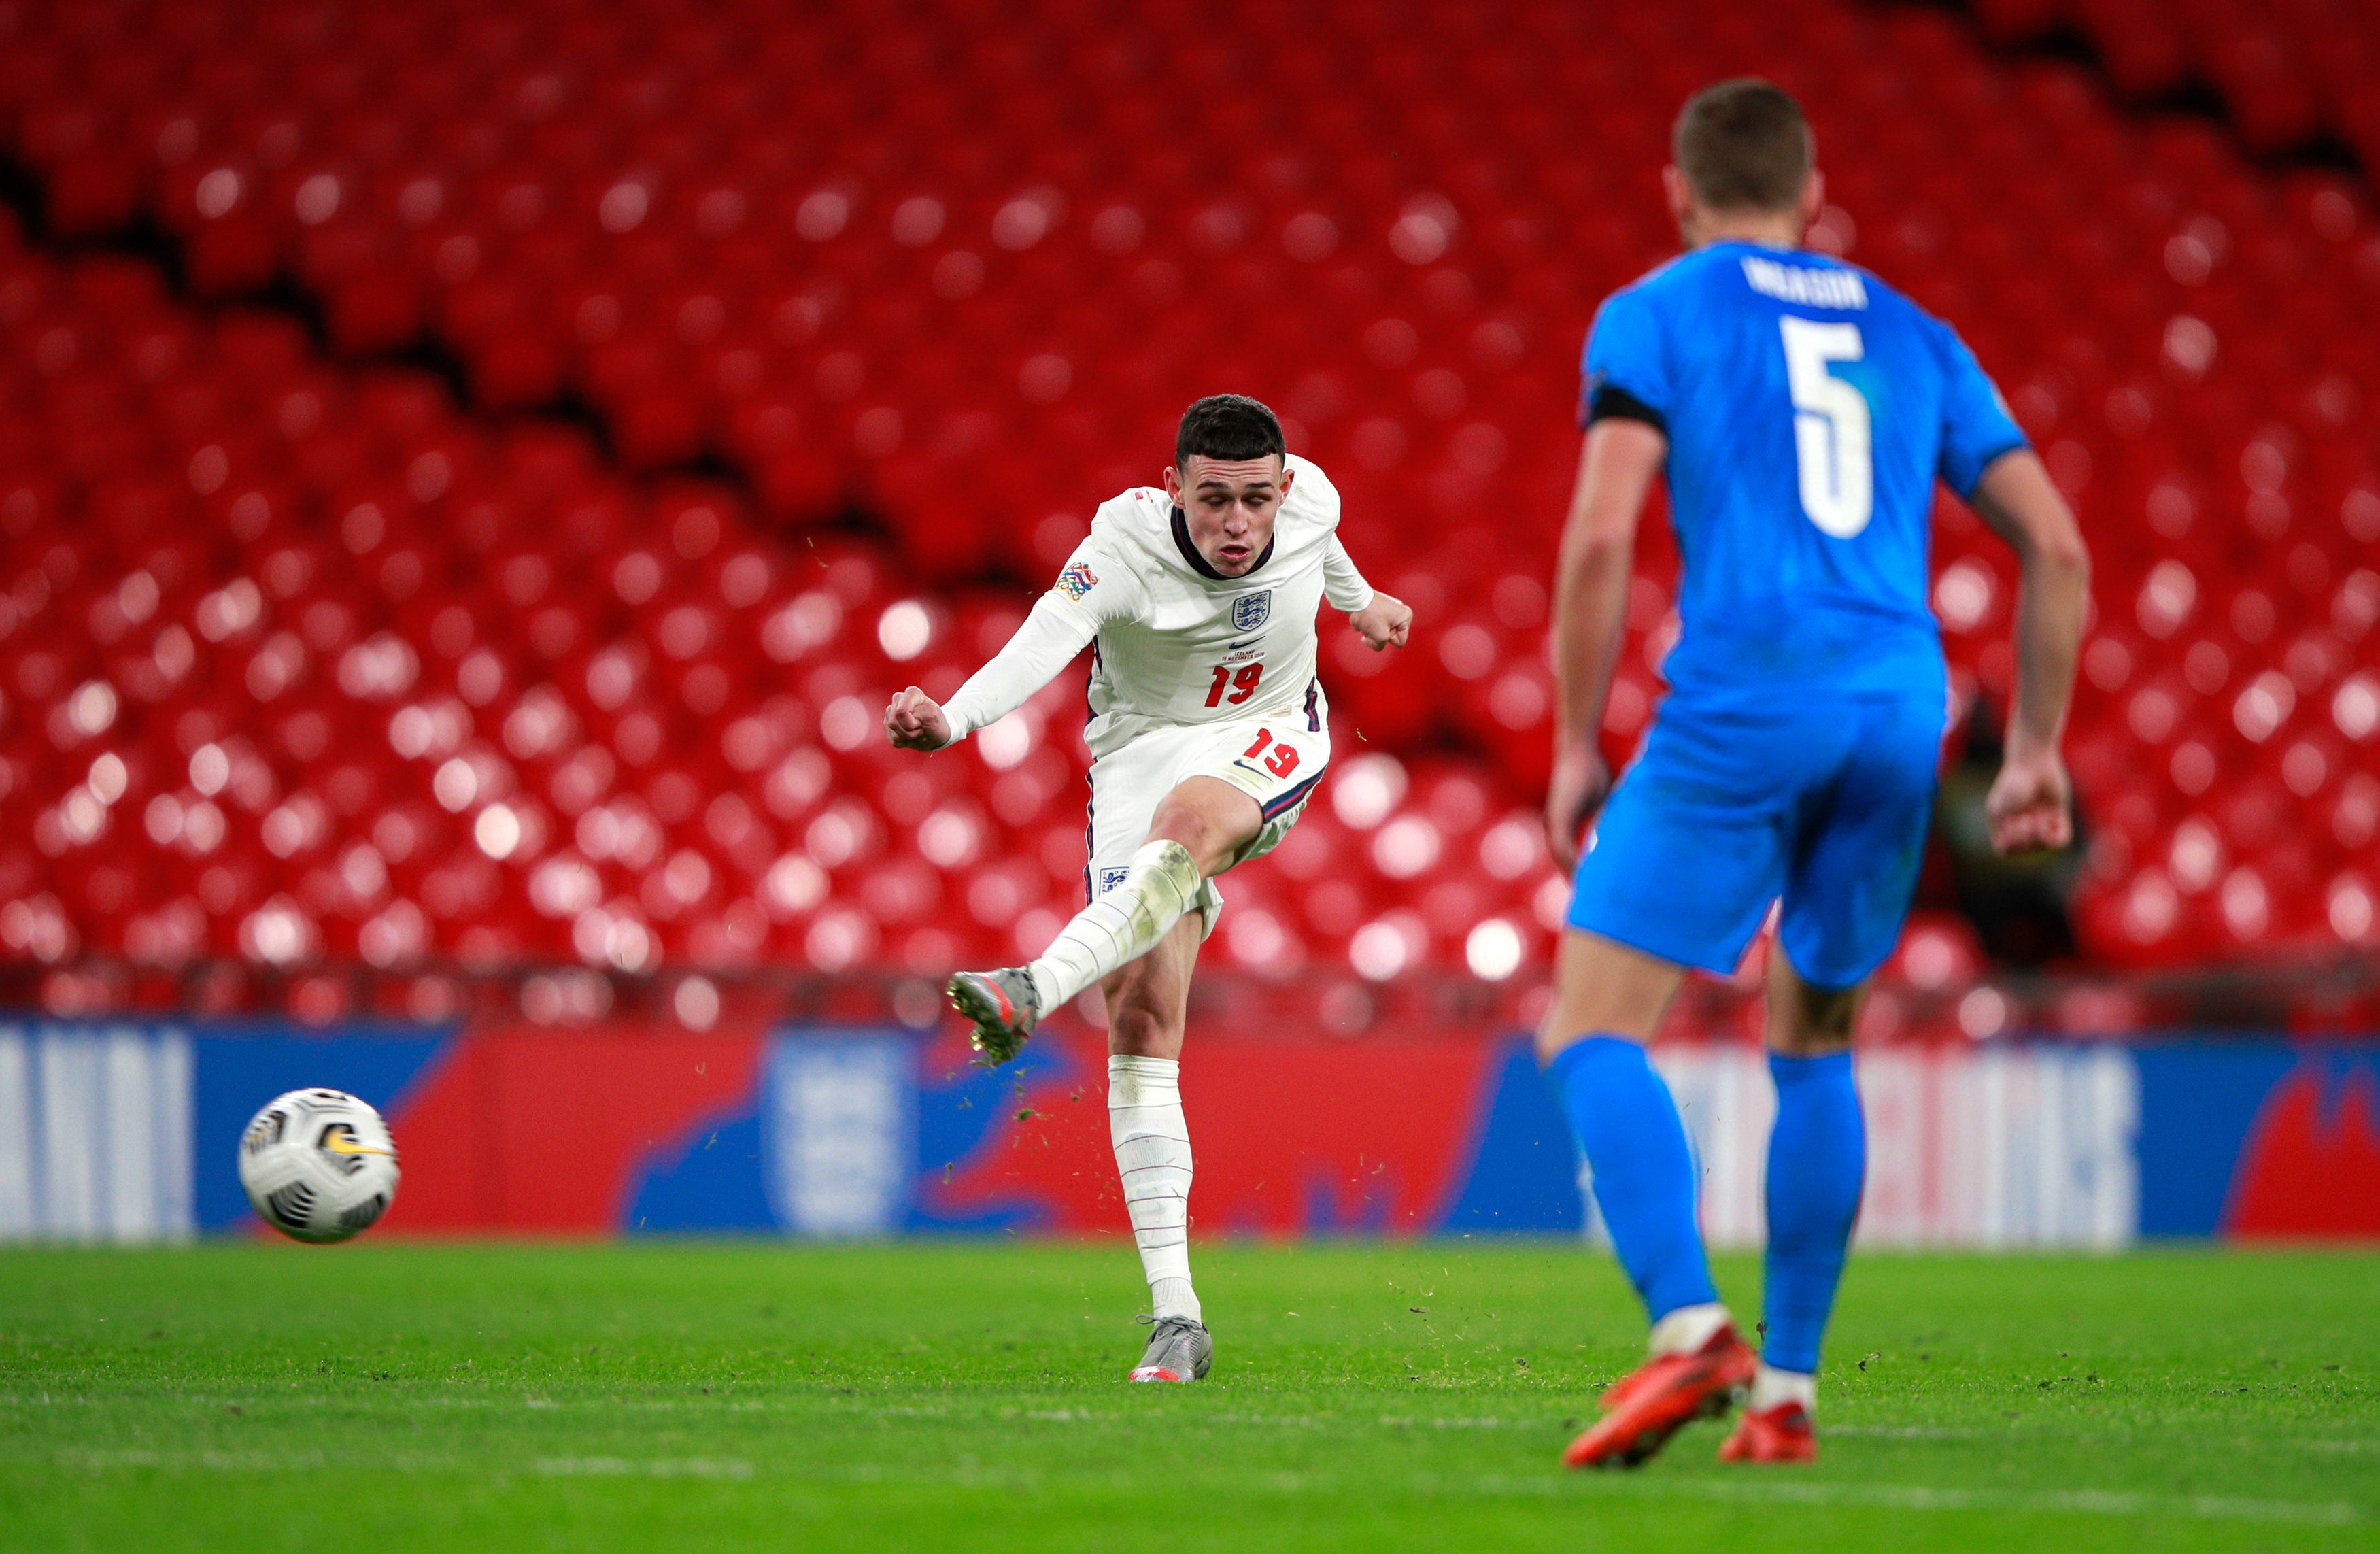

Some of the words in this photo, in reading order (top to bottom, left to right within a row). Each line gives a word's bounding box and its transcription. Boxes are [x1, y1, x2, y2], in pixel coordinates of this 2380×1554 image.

[1778, 314, 1874, 539] 5
[1204, 662, 1264, 707] 19
[1243, 728, 1300, 779] 19
